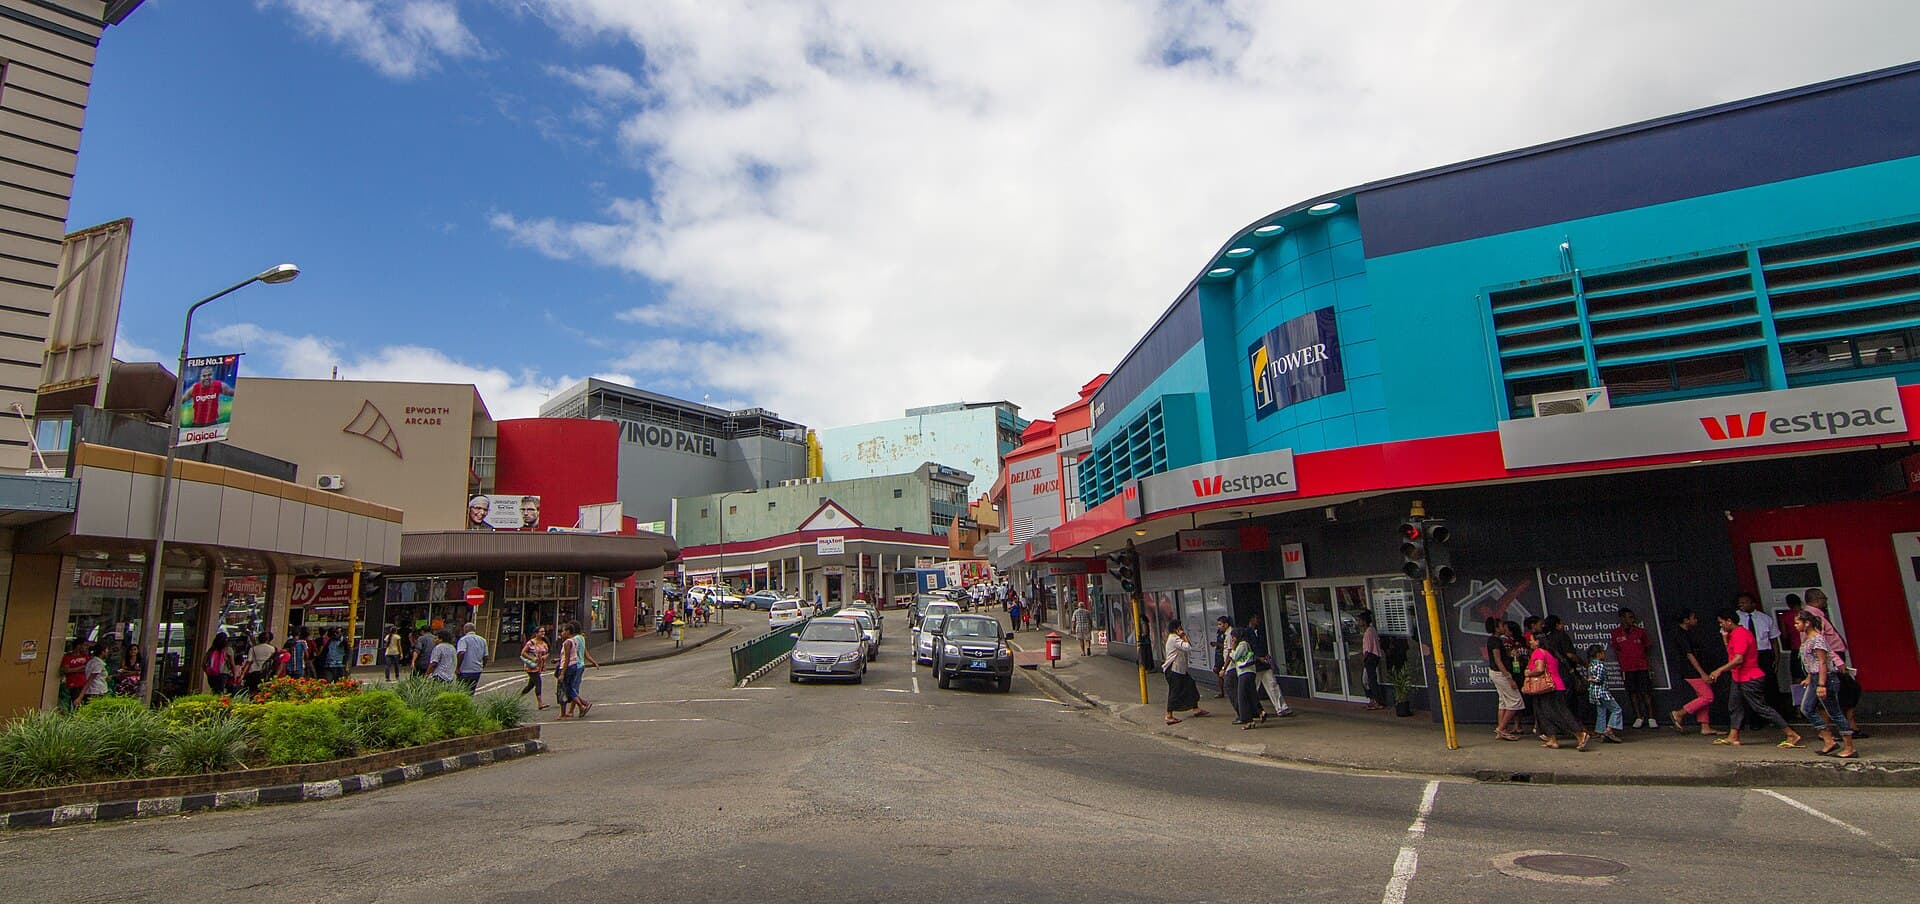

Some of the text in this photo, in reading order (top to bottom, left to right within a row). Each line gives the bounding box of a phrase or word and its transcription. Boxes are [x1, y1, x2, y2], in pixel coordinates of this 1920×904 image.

[1270, 343, 1329, 378] TOWER
[195, 393, 217, 402] Digicel
[405, 406, 450, 415] EPWORTH
[405, 417, 441, 426] ARCADE
[1700, 407, 1896, 440] Westpac
[186, 430, 218, 443] Digicel
[675, 432, 717, 457] PATEL
[1010, 467, 1042, 484] DELUXE
[1192, 470, 1289, 497] Westpac
[1547, 571, 1640, 586] Competitive
[227, 579, 263, 594] Pharmacy
[1565, 586, 1625, 599] Interest
[1576, 601, 1619, 613] Rates
[1571, 622, 1592, 631] New
